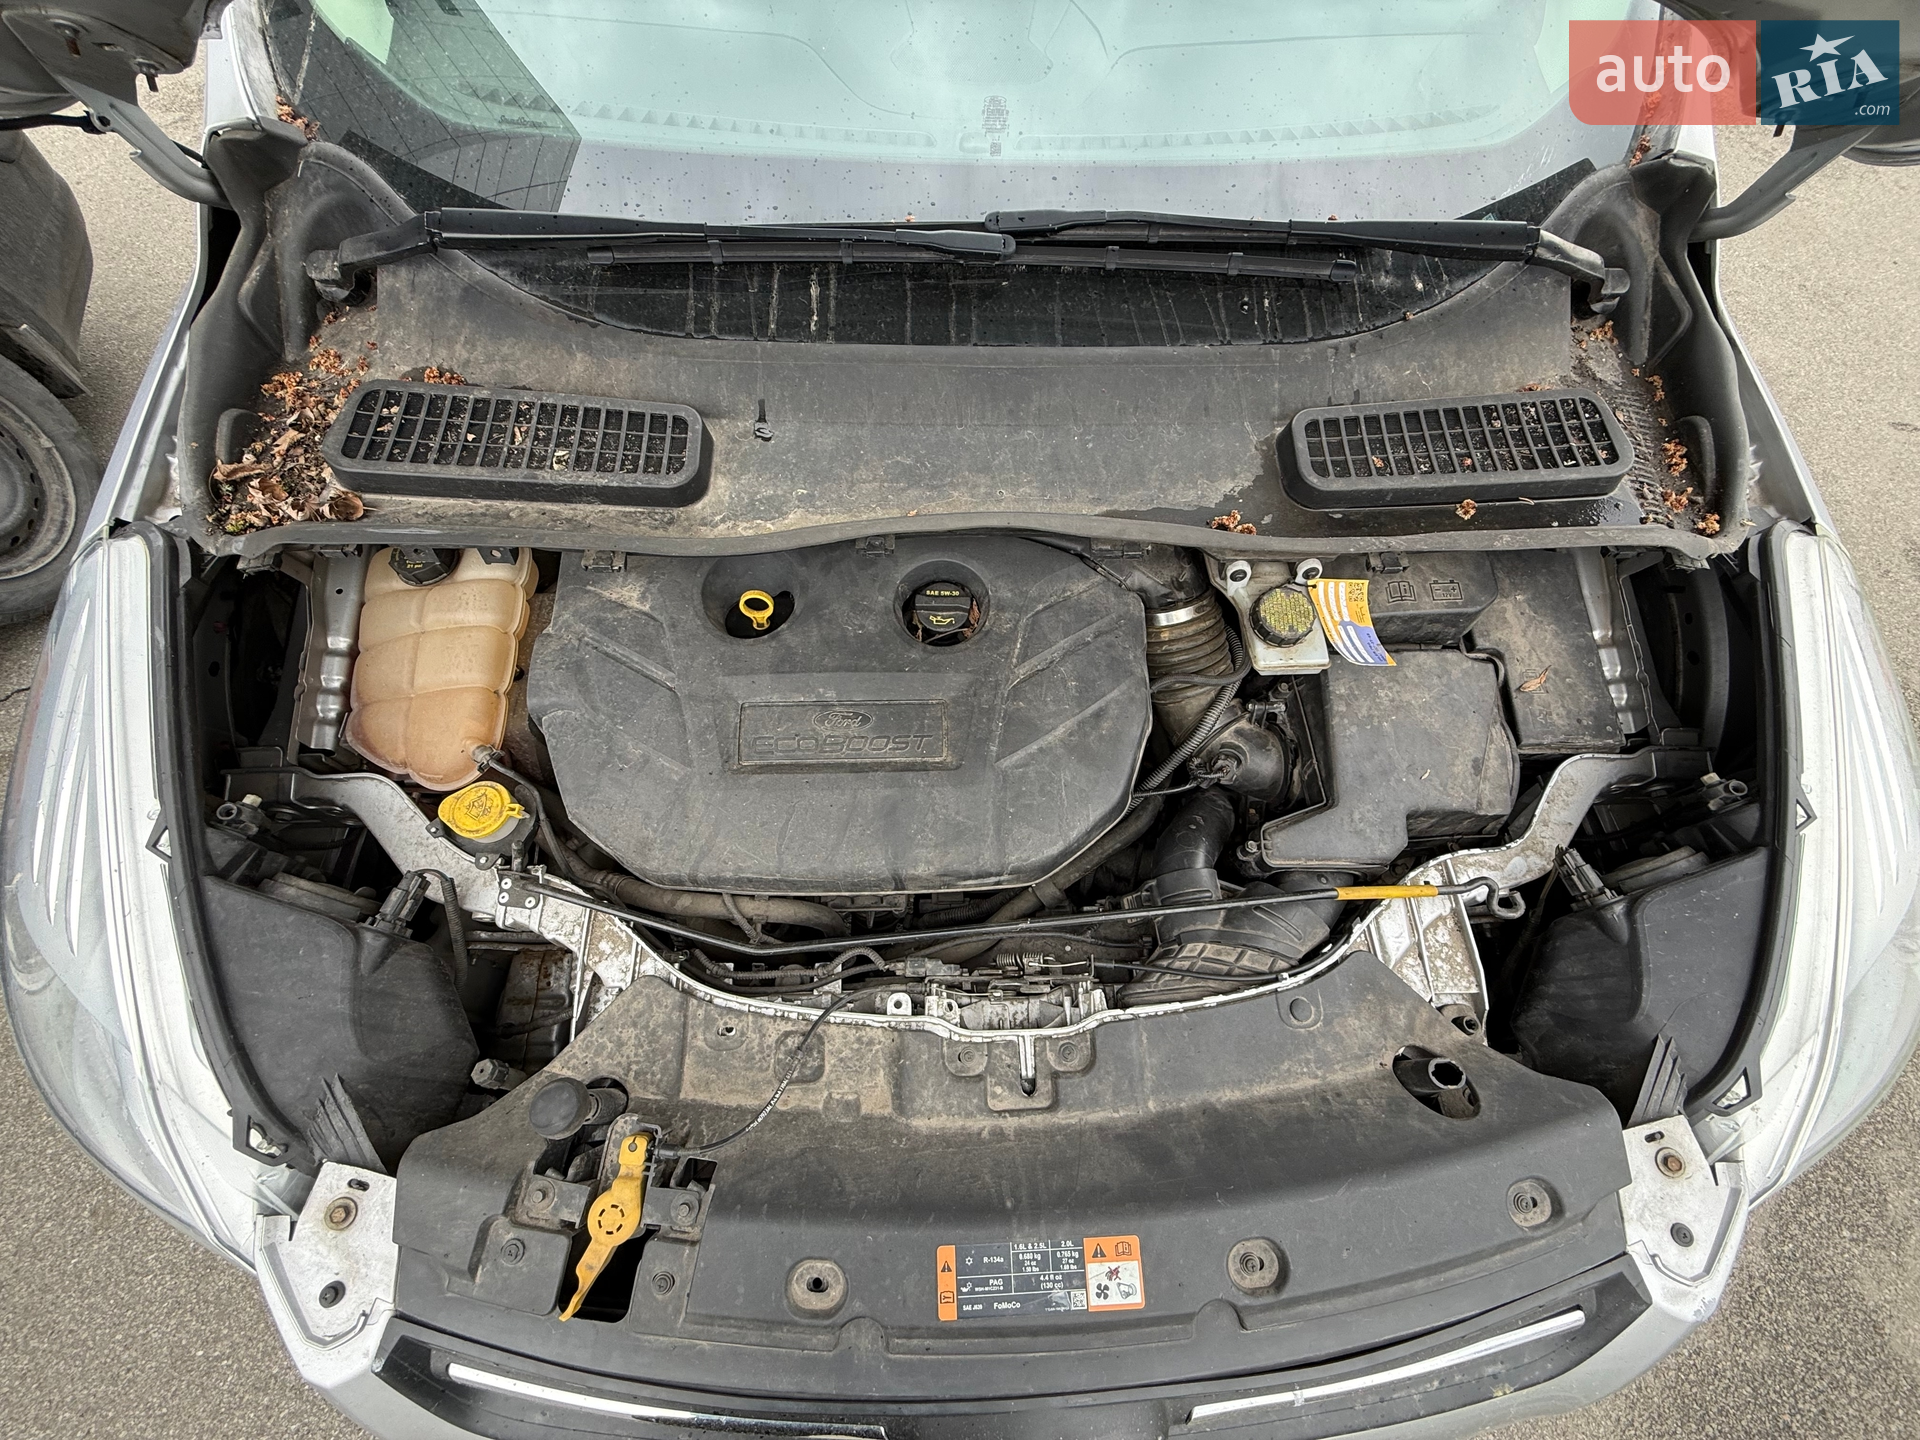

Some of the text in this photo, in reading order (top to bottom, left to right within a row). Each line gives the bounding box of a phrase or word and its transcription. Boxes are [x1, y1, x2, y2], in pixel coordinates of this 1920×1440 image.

[824, 711, 862, 728] Ford
[1027, 1242, 1033, 1250] &
[1033, 1252, 1041, 1261] kg
[1071, 1250, 1079, 1258] kg
[983, 1256, 1004, 1264] R-134a
[989, 1278, 1003, 1286] PAG
[1040, 1281, 1064, 1290] (130 cc)
[994, 1301, 1021, 1310] FoMoCo
